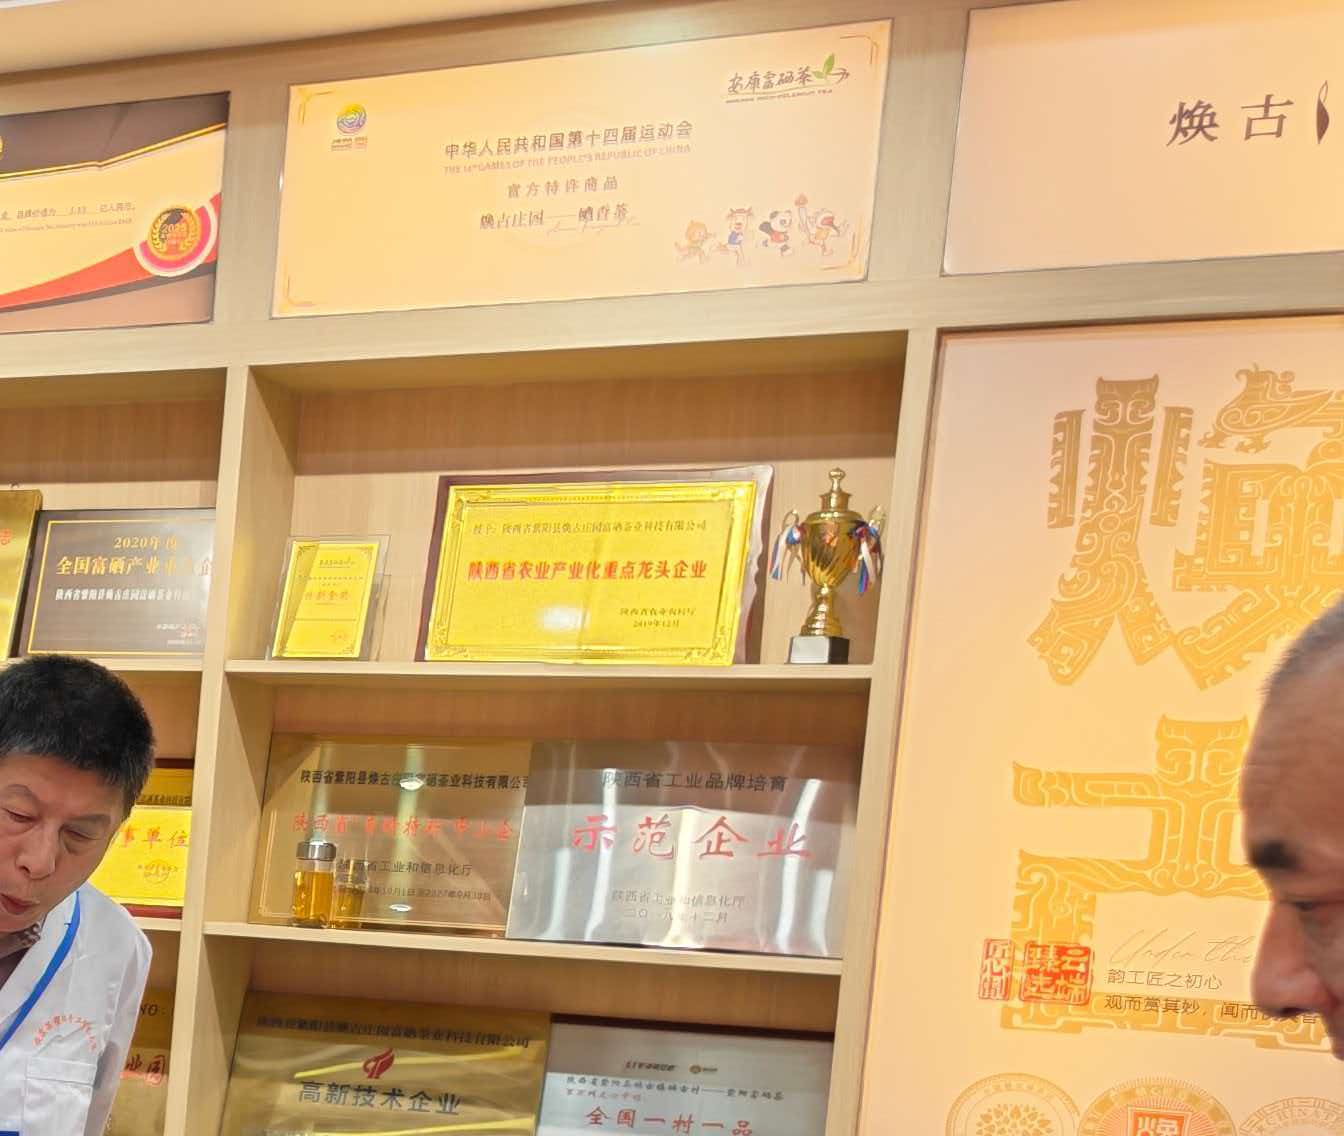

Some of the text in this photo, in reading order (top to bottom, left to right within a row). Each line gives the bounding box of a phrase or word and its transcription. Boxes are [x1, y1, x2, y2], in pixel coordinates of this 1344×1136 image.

[1165, 93, 1295, 148] 焕古
[445, 120, 694, 161] 中华人民共和国第十四届运动会
[467, 559, 709, 582] 陕西省农业产业化重点龙头企业
[602, 771, 789, 793] 陕西省工业品牌培育
[571, 813, 816, 861] 示范企业
[1106, 968, 1224, 991] 韵工匠之初心
[298, 1079, 463, 1116] 高新技术企业
[585, 1105, 754, 1136] 全国一村一品
